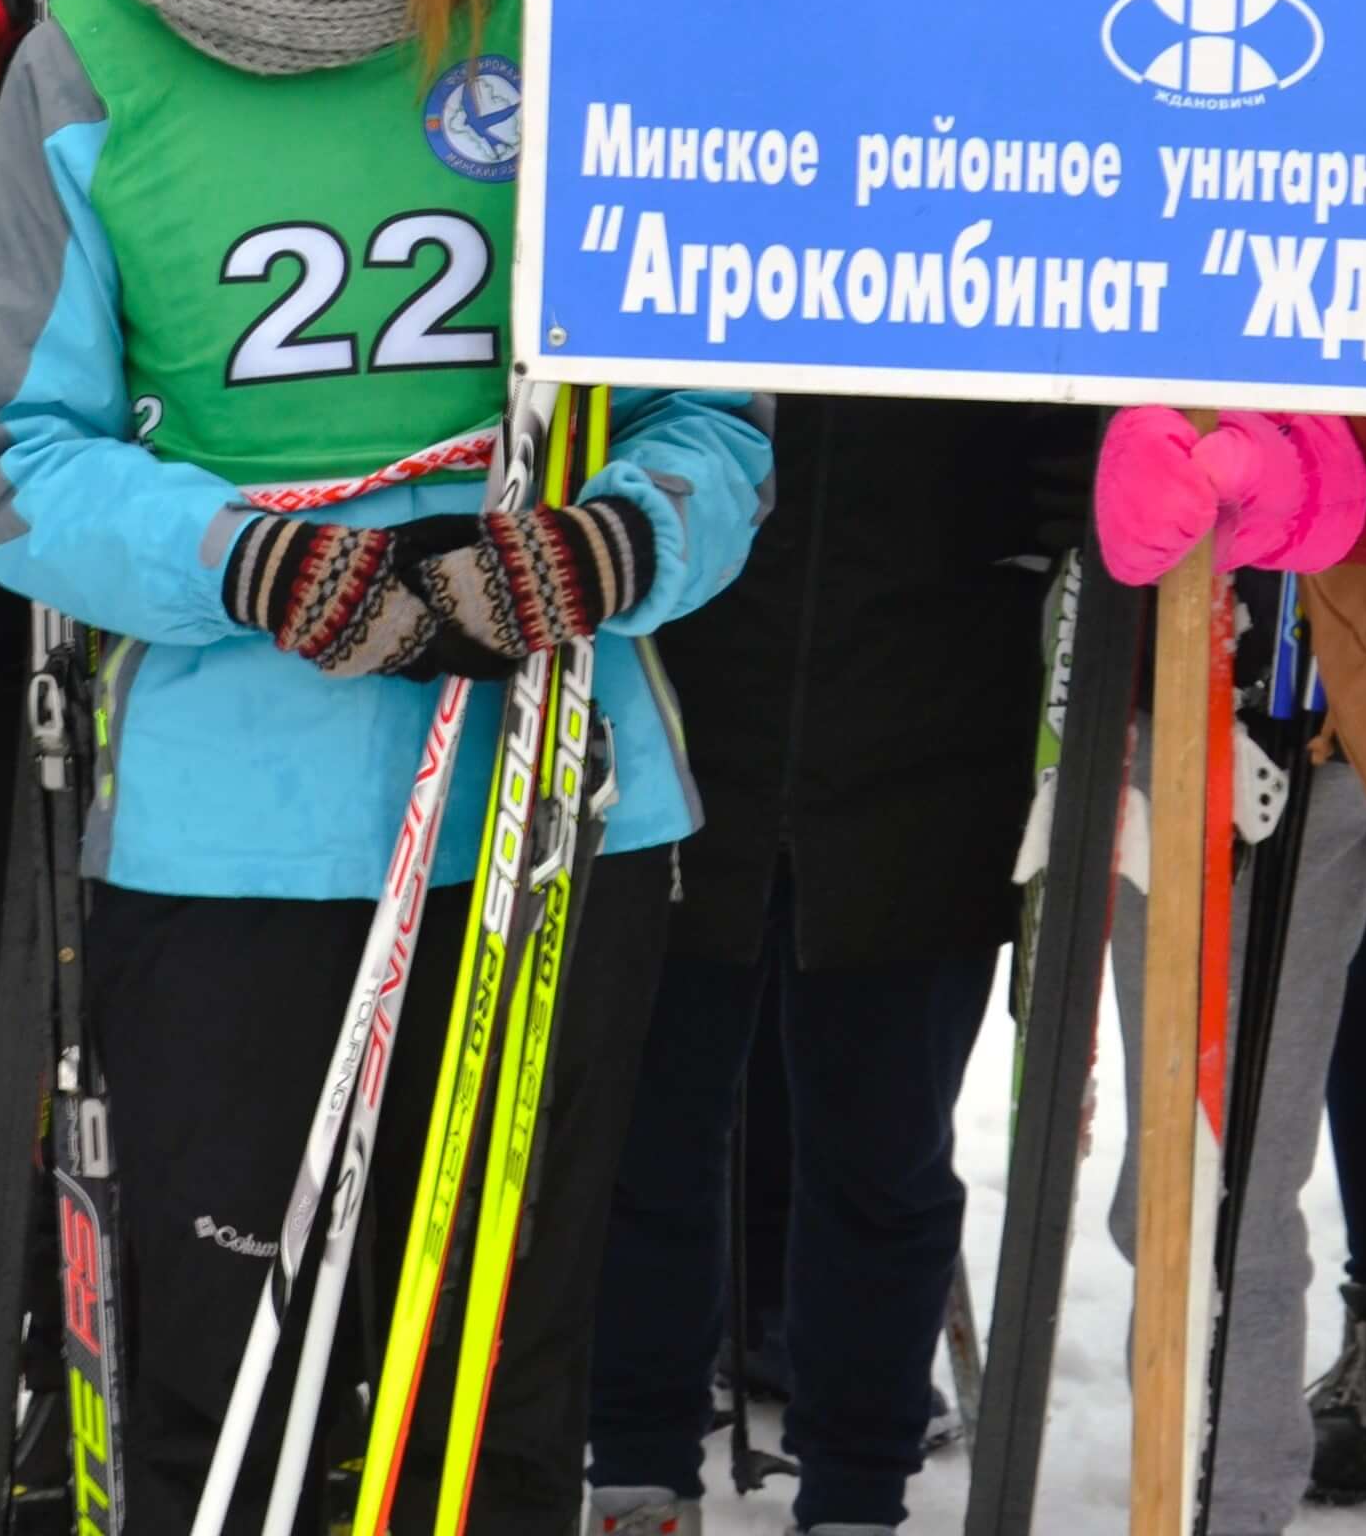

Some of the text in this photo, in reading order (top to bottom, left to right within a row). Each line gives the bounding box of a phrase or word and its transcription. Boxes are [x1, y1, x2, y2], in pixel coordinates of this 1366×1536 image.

[581, 102, 820, 186] Минское
[856, 115, 1122, 207] районное
[1152, 88, 1267, 111] ЖДАНОВИЧИ
[218, 209, 502, 389] 22
[329, 982, 379, 1114] TOURING
